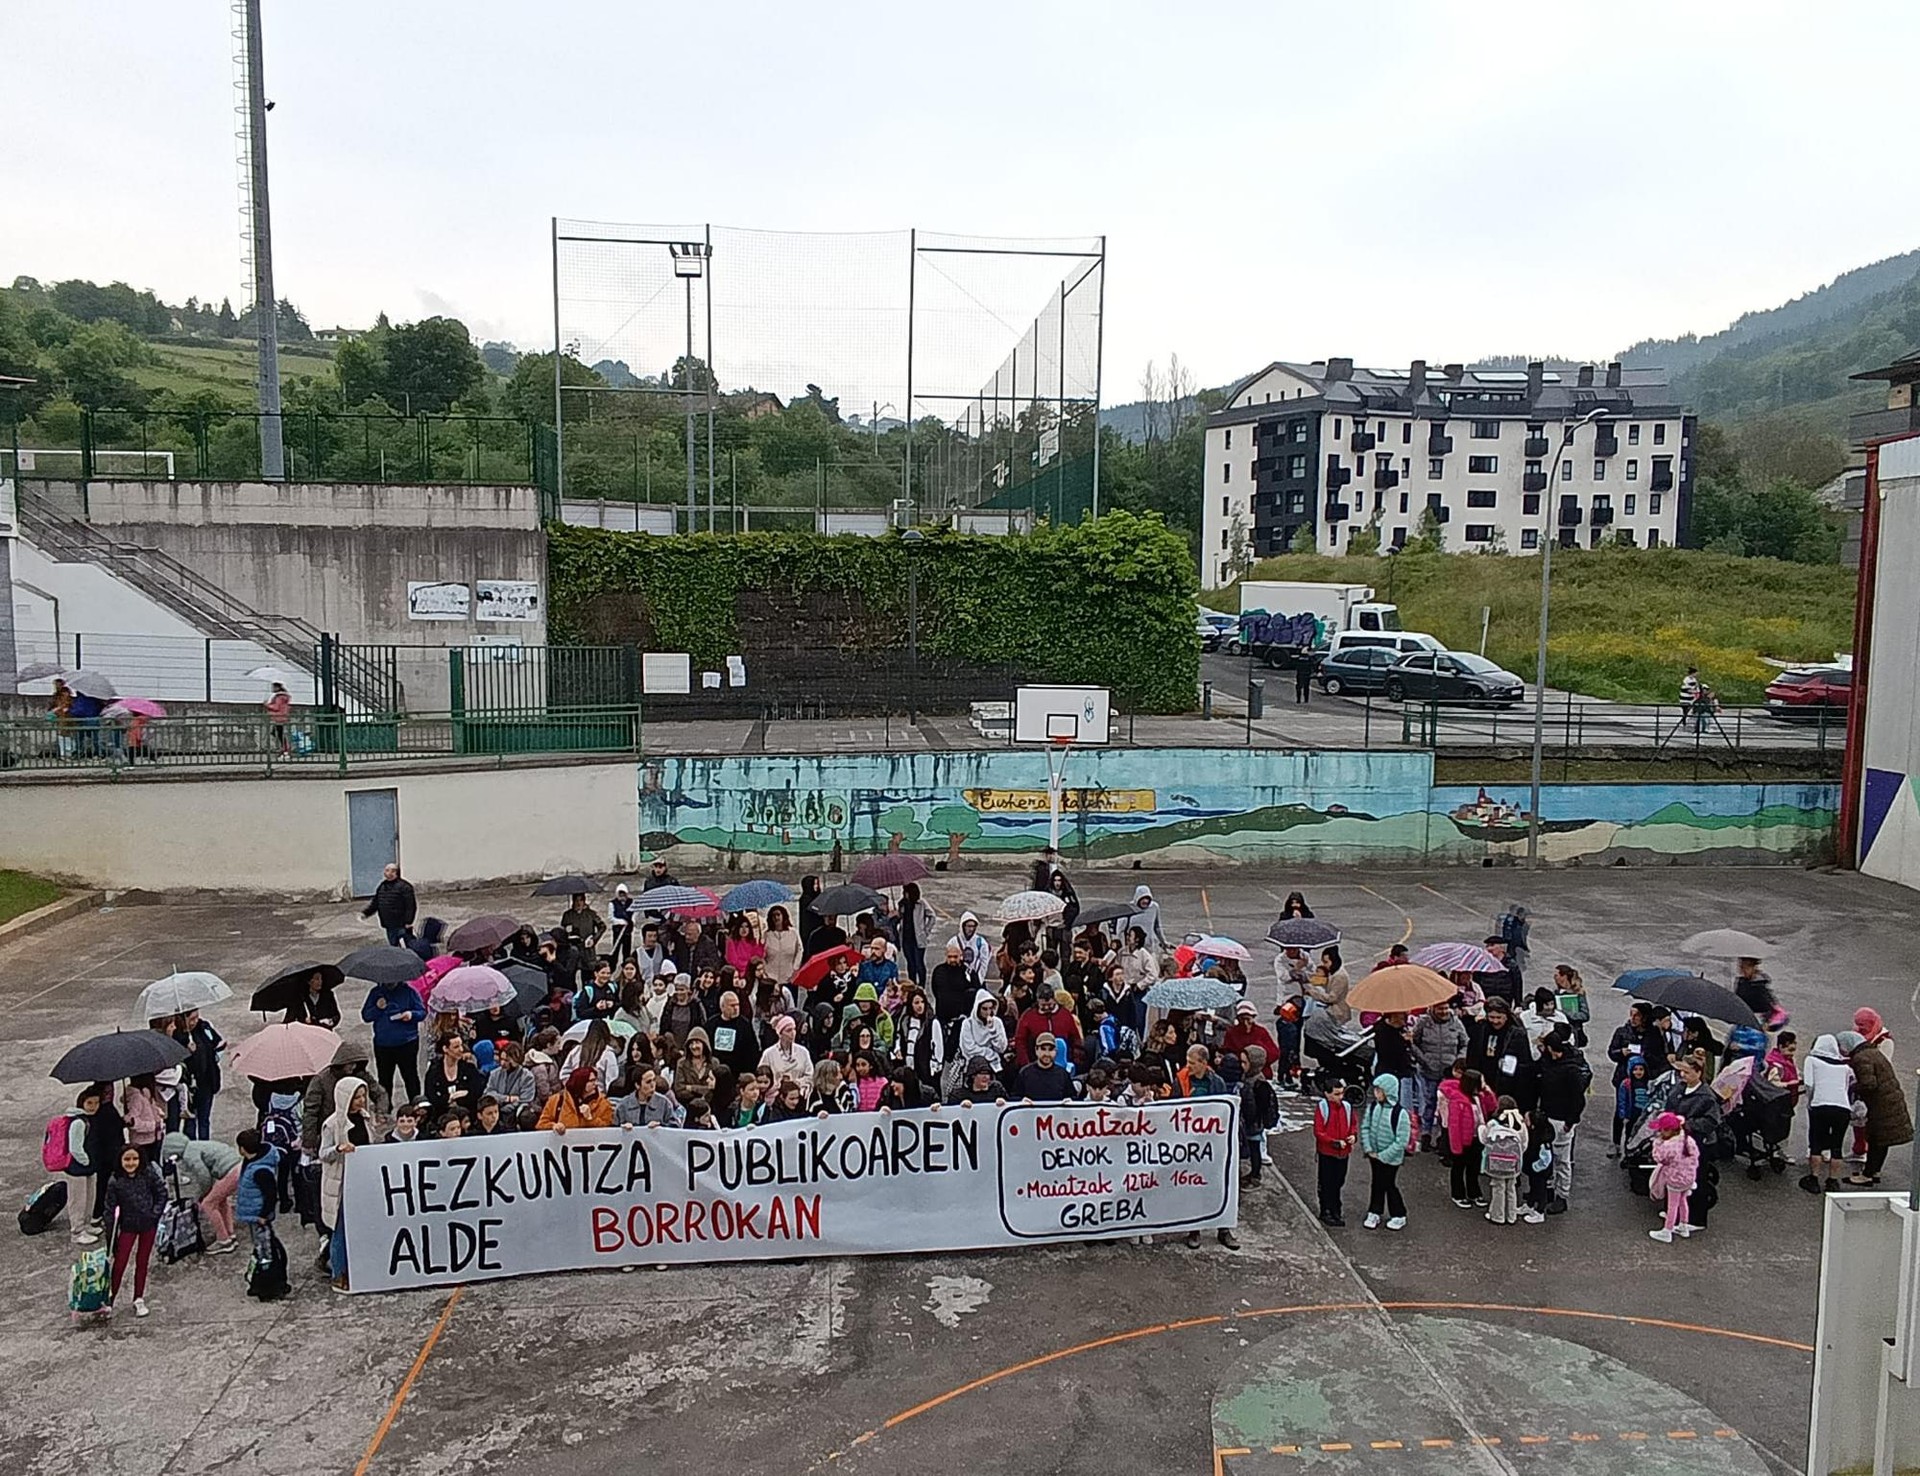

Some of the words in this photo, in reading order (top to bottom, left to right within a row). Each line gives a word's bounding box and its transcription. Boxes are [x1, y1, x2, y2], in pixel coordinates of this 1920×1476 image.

[1036, 1109, 1157, 1141] Maiatzak
[1169, 1107, 1226, 1134] 17an
[1042, 1146, 1113, 1171] DENOK
[381, 1141, 652, 1217] HEZKUNTZA
[1027, 1174, 1113, 1199] Maiatzak
[1122, 1173, 1160, 1192] 12tik
[1170, 1170, 1209, 1187] 16ra
[1060, 1198, 1147, 1229] GREBA
[389, 1219, 503, 1276] ALDE
[592, 1195, 822, 1253] BORROKAN
